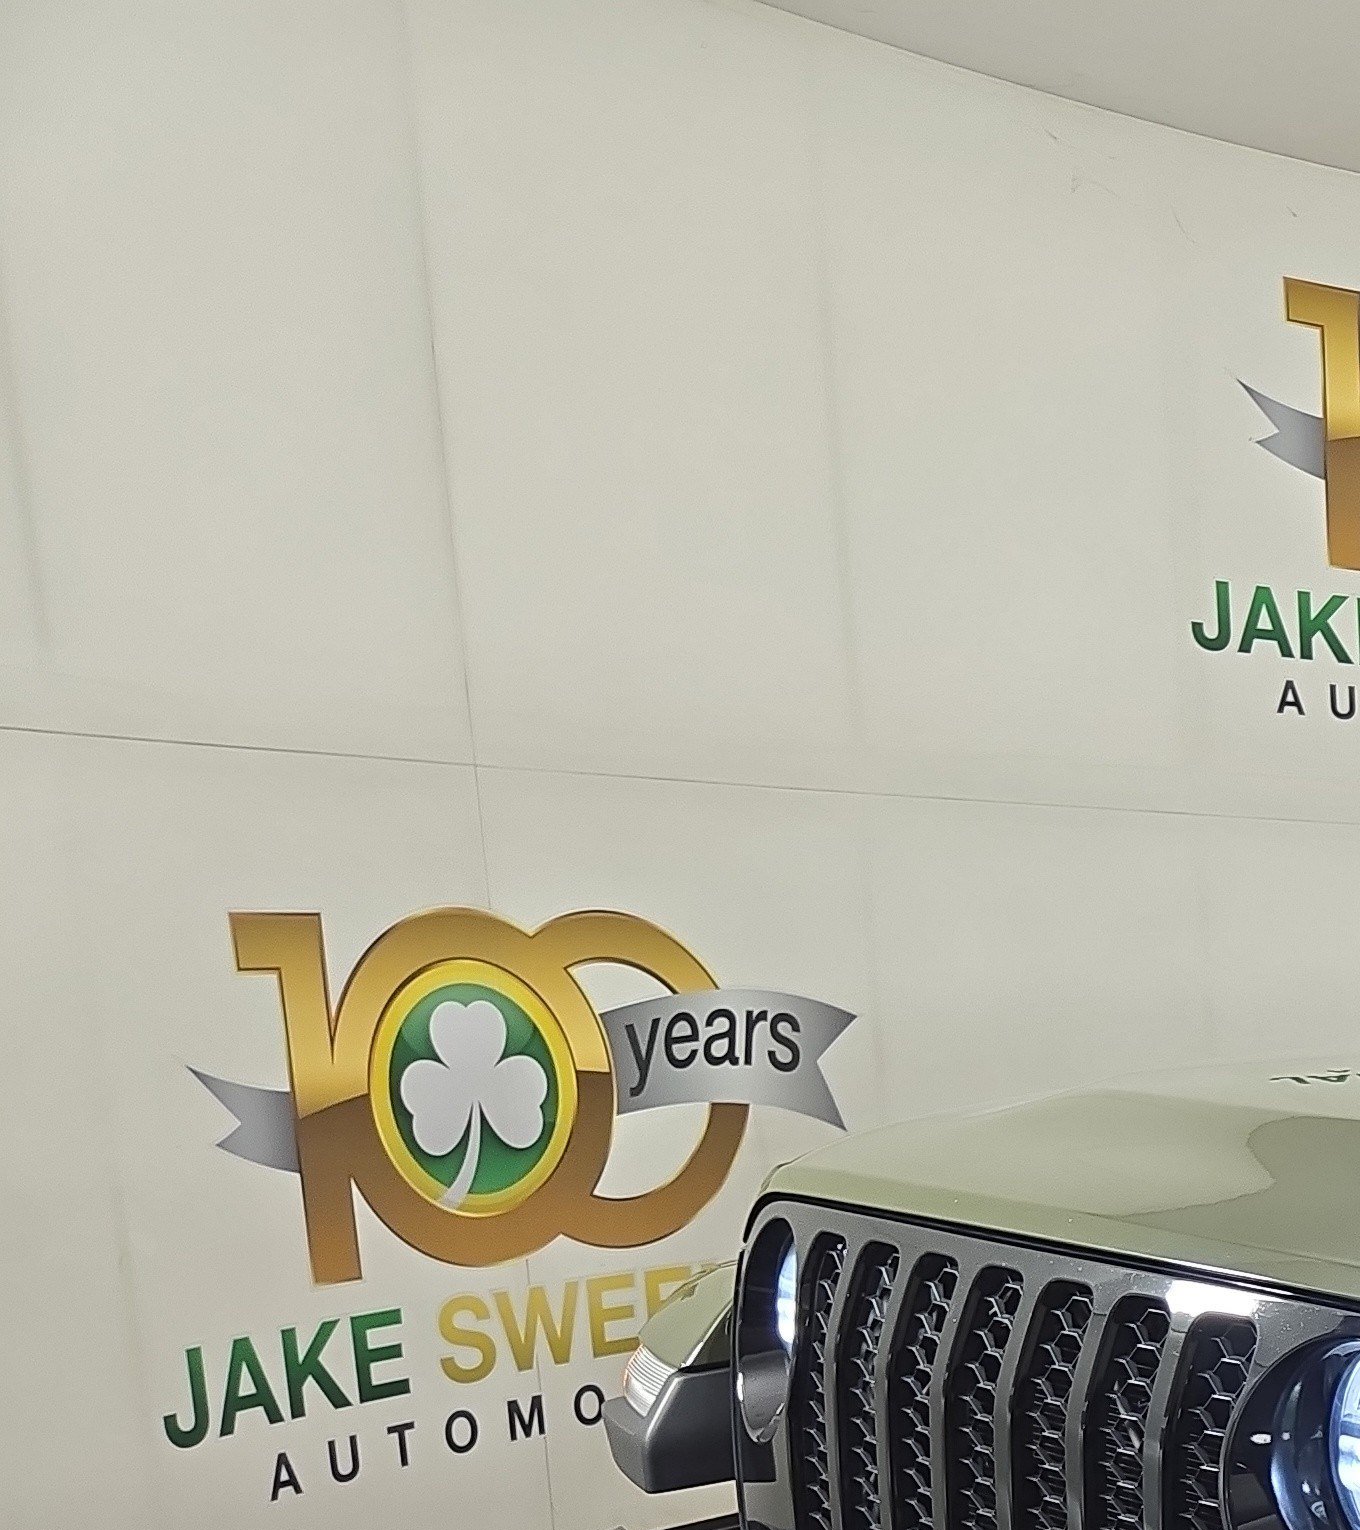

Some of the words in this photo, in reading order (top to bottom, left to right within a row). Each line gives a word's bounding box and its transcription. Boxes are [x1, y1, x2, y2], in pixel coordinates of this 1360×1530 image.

[228, 906, 748, 1285] 100
[625, 1007, 801, 1098] years
[162, 1307, 411, 1449] JAKE
[269, 1384, 605, 1502] AUTOMO
